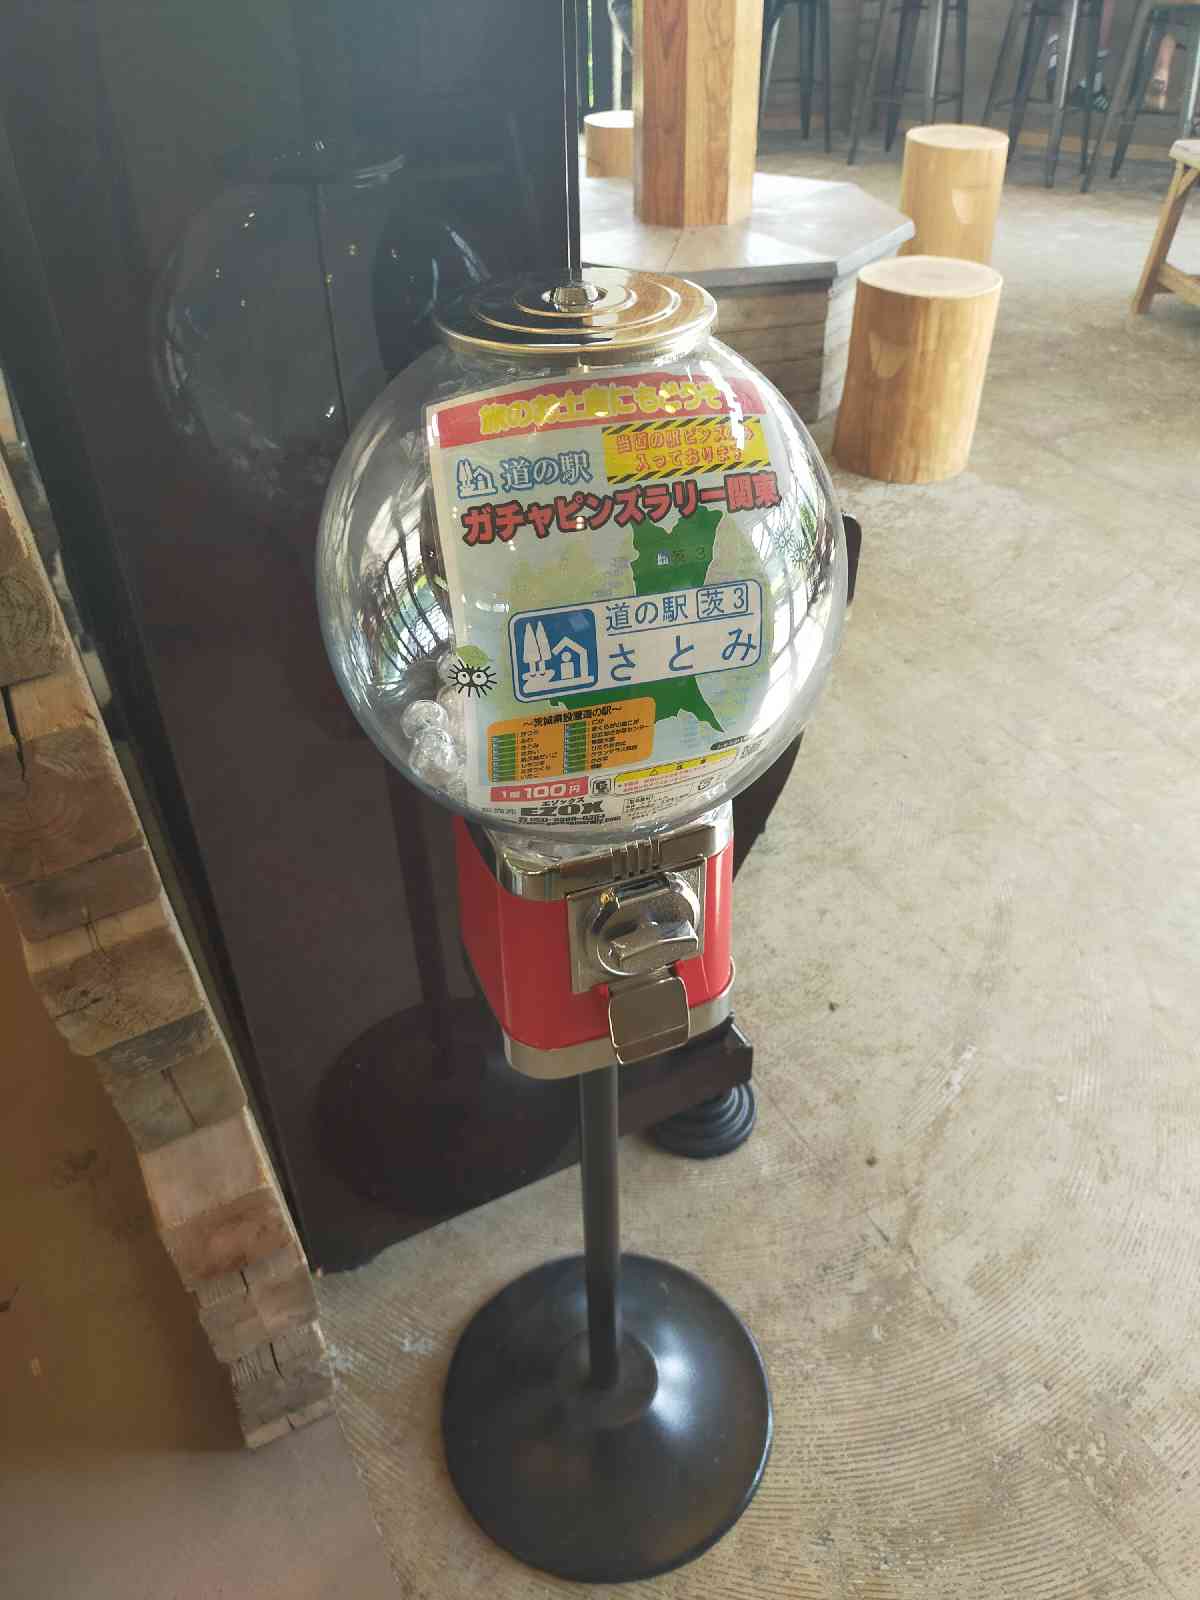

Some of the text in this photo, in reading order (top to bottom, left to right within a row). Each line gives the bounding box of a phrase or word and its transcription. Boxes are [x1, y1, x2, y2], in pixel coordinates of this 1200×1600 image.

[500, 450, 592, 492] 道の駅
[460, 471, 781, 545] ガチャピンズラリー関東
[605, 594, 689, 632] 道の駅
[609, 628, 756, 682] さとみ
[520, 801, 604, 816] EZOX
